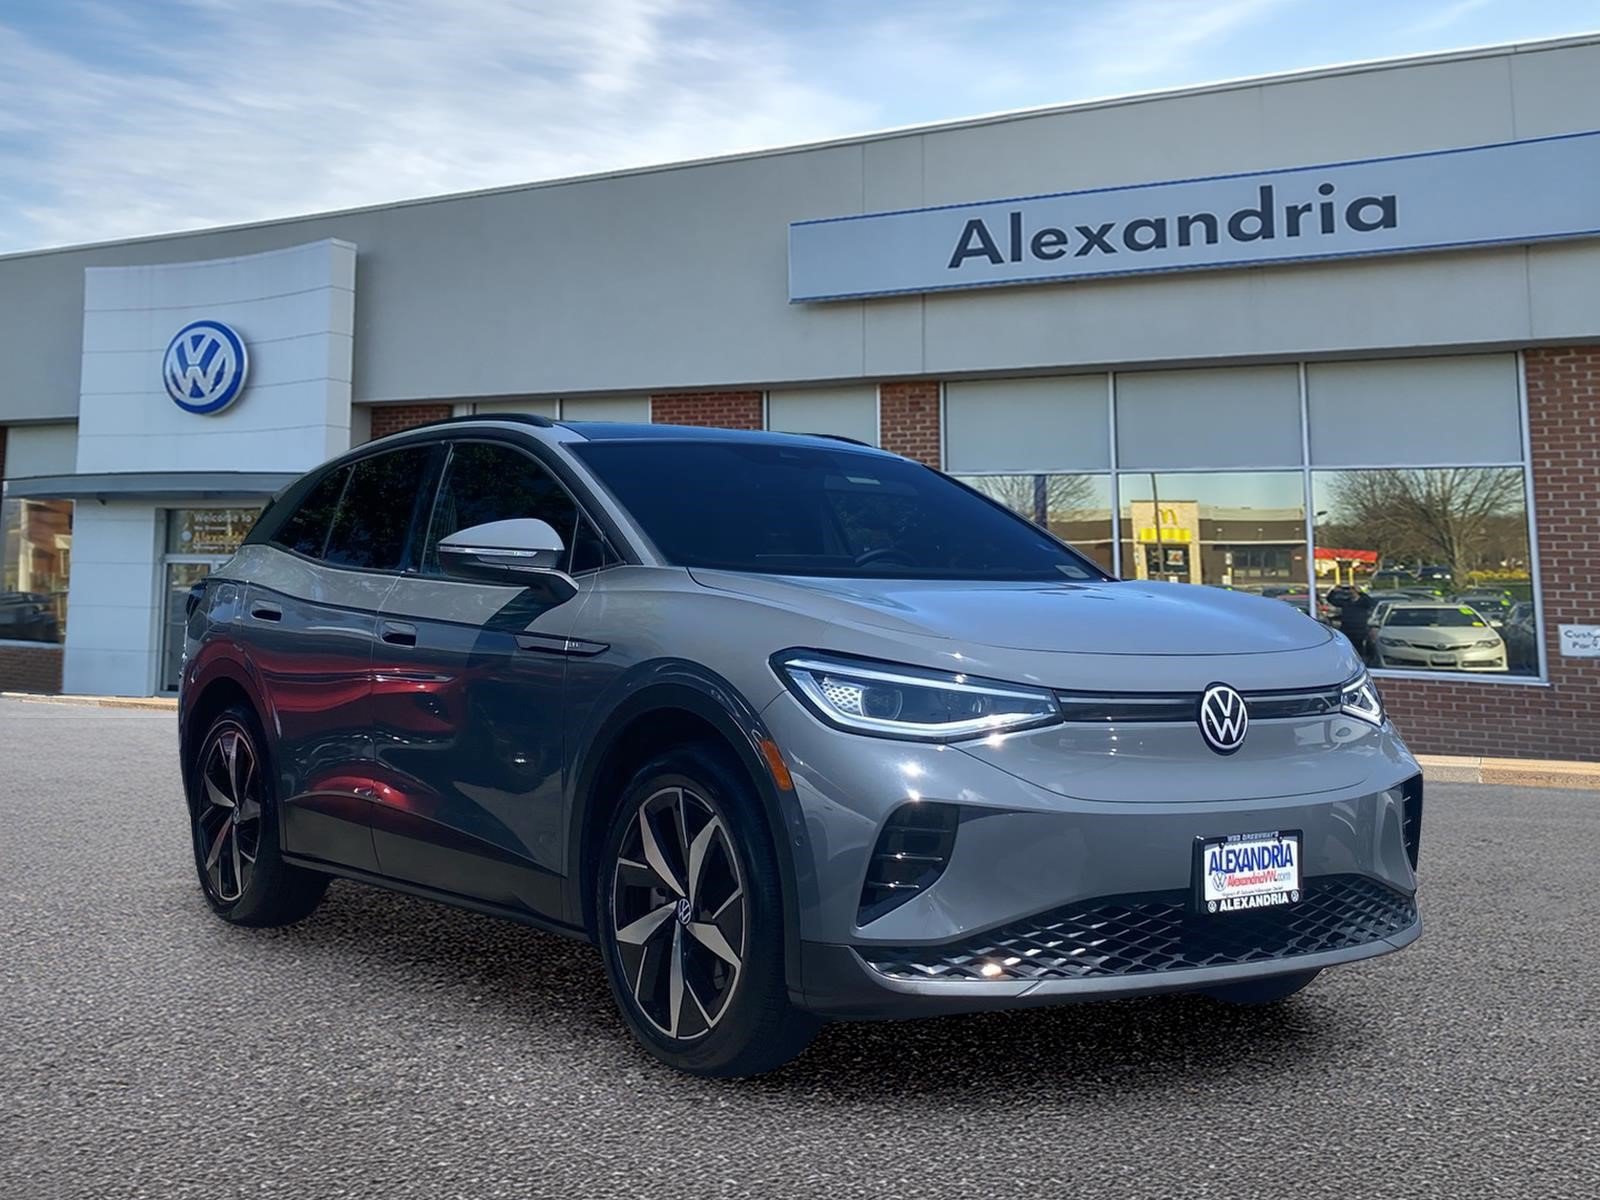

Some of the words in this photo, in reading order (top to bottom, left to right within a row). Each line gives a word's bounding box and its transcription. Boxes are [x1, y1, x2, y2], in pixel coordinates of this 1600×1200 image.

[947, 183, 1398, 268] Alexandria
[194, 512, 238, 523] Welcome
[241, 514, 252, 523] to
[1208, 844, 1293, 875] ALEXANDRIA
[1219, 893, 1289, 911] ALEXANDRIA
